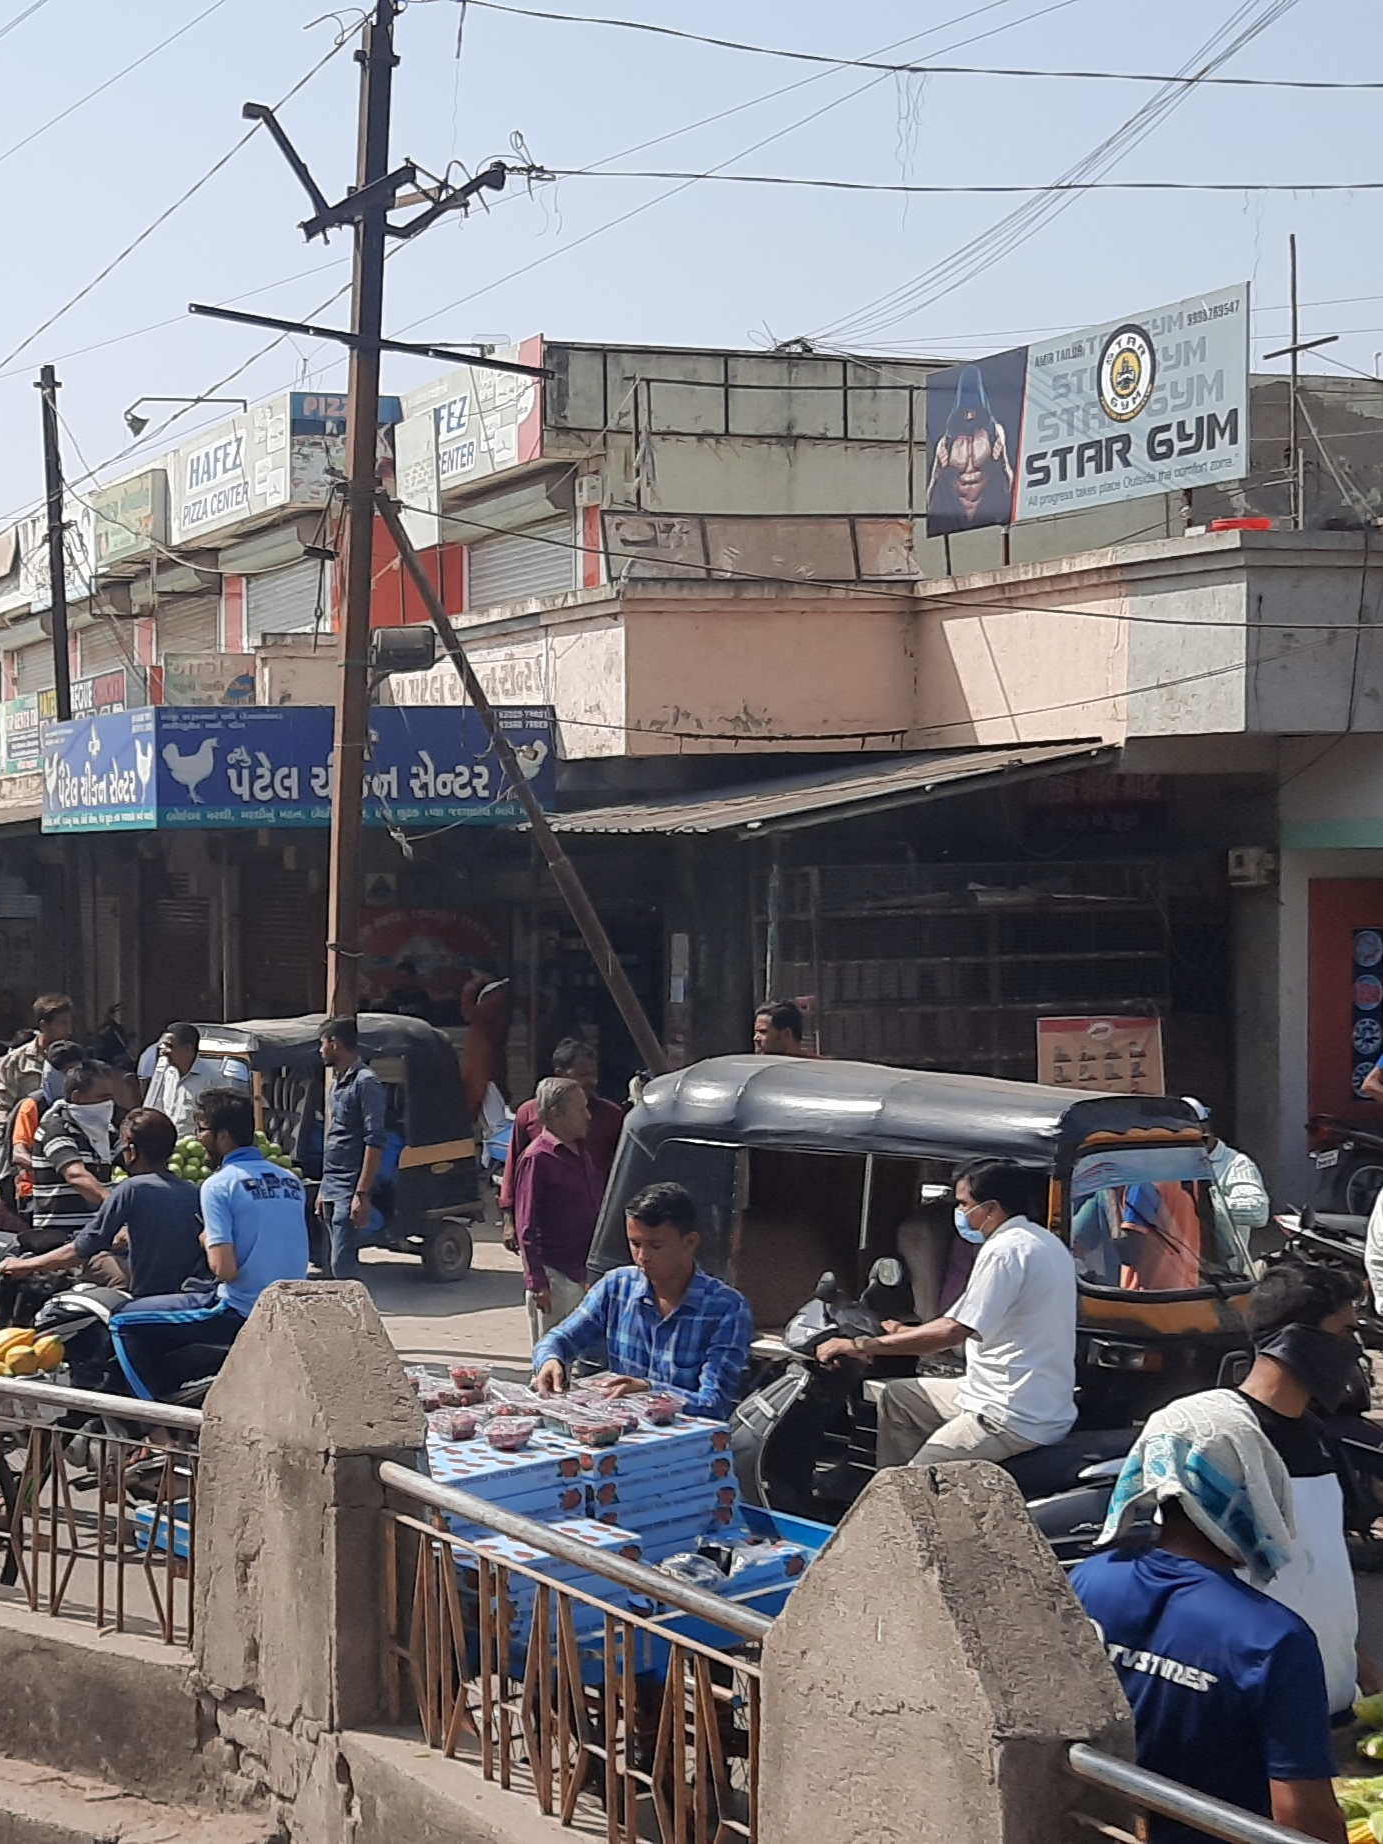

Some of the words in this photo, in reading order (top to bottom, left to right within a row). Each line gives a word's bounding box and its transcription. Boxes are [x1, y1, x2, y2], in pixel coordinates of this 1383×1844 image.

[189, 436, 243, 490] HAFEZ
[439, 441, 475, 476] ENTER
[1025, 434, 1132, 489] STAR
[1147, 407, 1239, 461] GYM
[182, 498, 208, 528] PIZZA
[210, 480, 249, 516] CENTER
[227, 751, 300, 802] પટેલ
[409, 750, 490, 799] સેન્ટર
[251, 1187, 280, 1201] MED.
